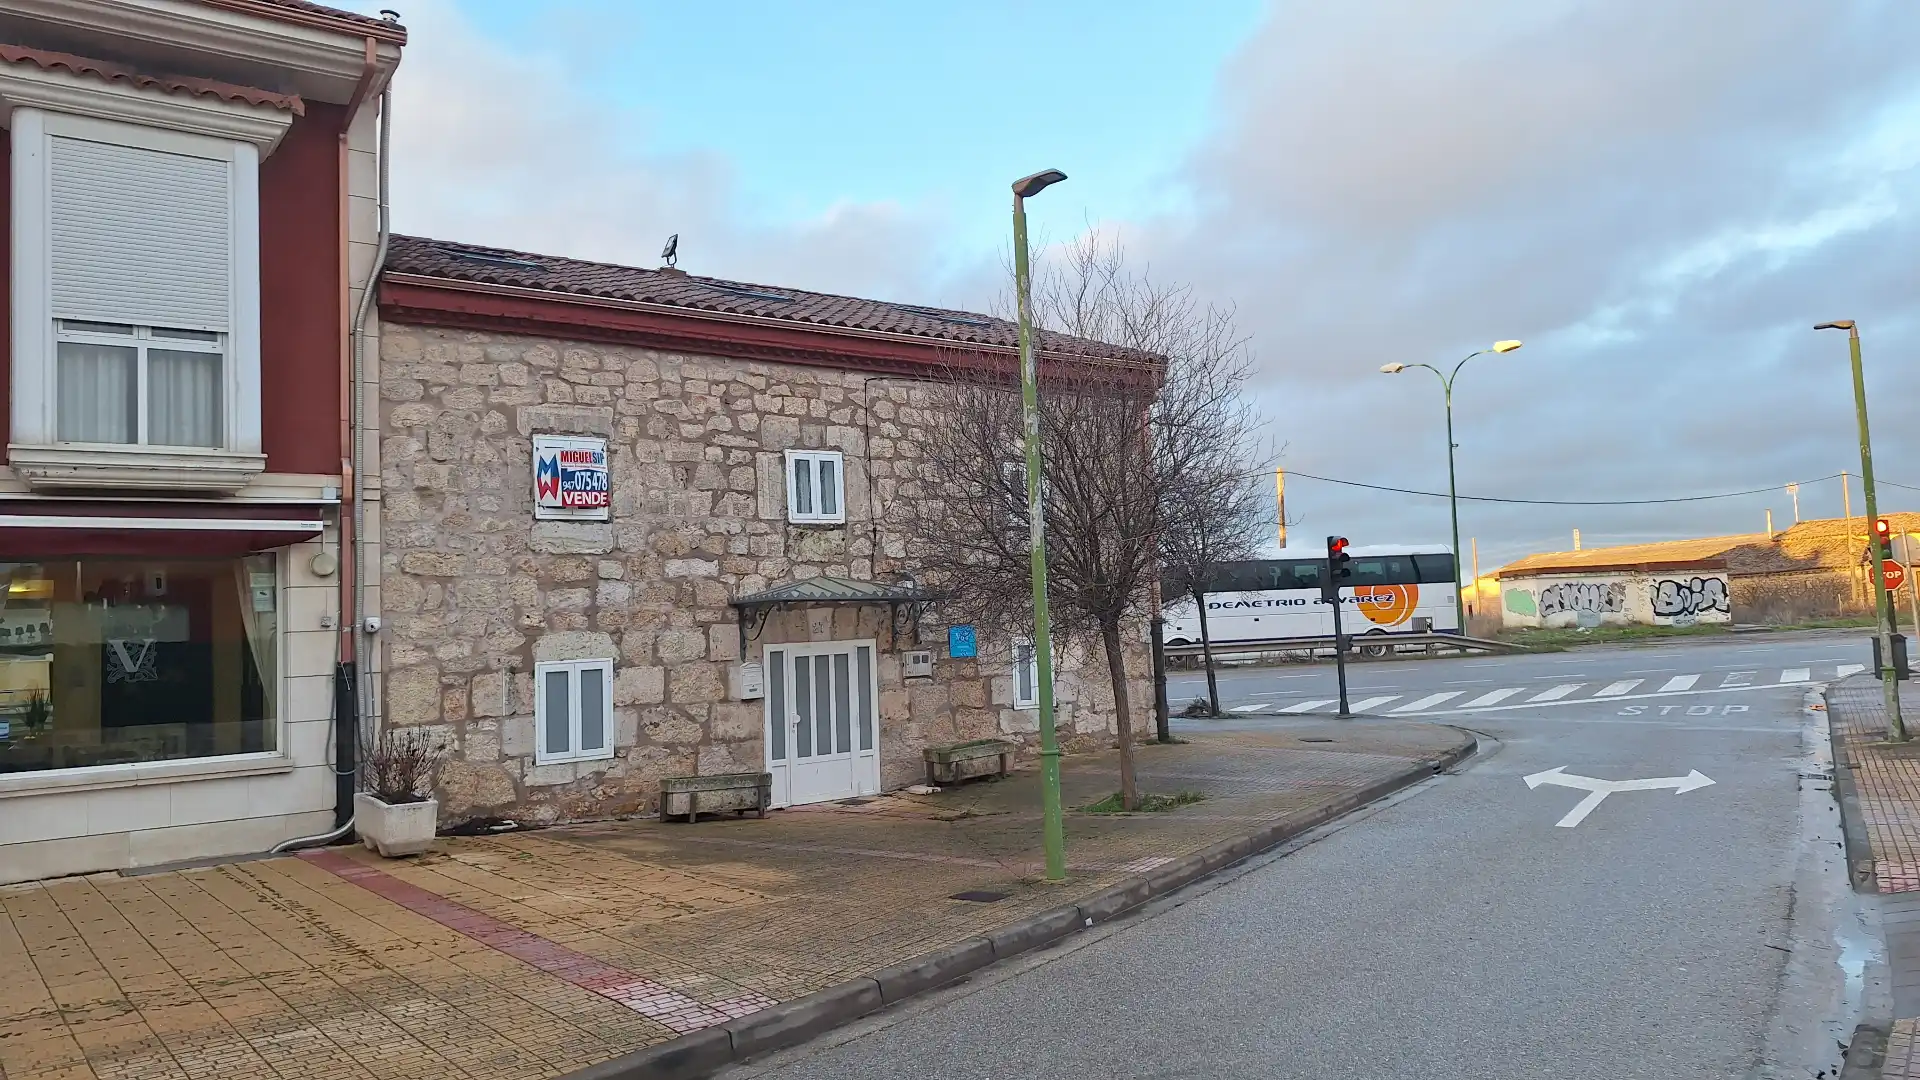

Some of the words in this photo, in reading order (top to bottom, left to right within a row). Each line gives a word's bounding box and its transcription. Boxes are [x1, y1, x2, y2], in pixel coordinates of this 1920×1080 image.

[563, 492, 608, 505] VENDE
[1871, 571, 1902, 579] OP
[1209, 599, 1306, 609] DEMETRIO
[1616, 705, 1750, 716] STOP
